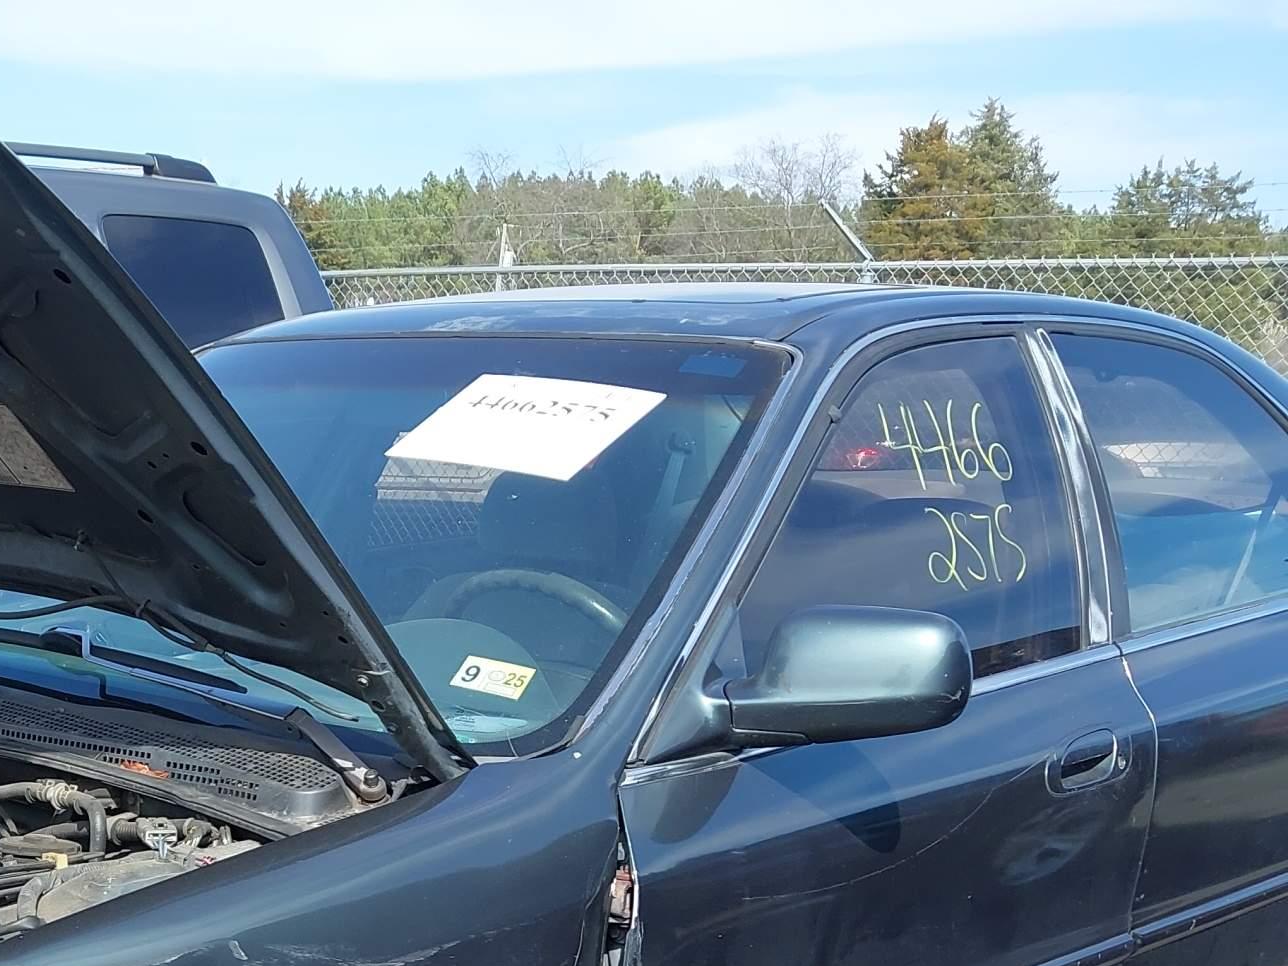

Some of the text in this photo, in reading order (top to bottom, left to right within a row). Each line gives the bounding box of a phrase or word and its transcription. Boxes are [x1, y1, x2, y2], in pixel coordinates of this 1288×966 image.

[877, 399, 1013, 491] 4466
[924, 503, 1027, 592] 2575
[461, 665, 528, 688] 9 25
